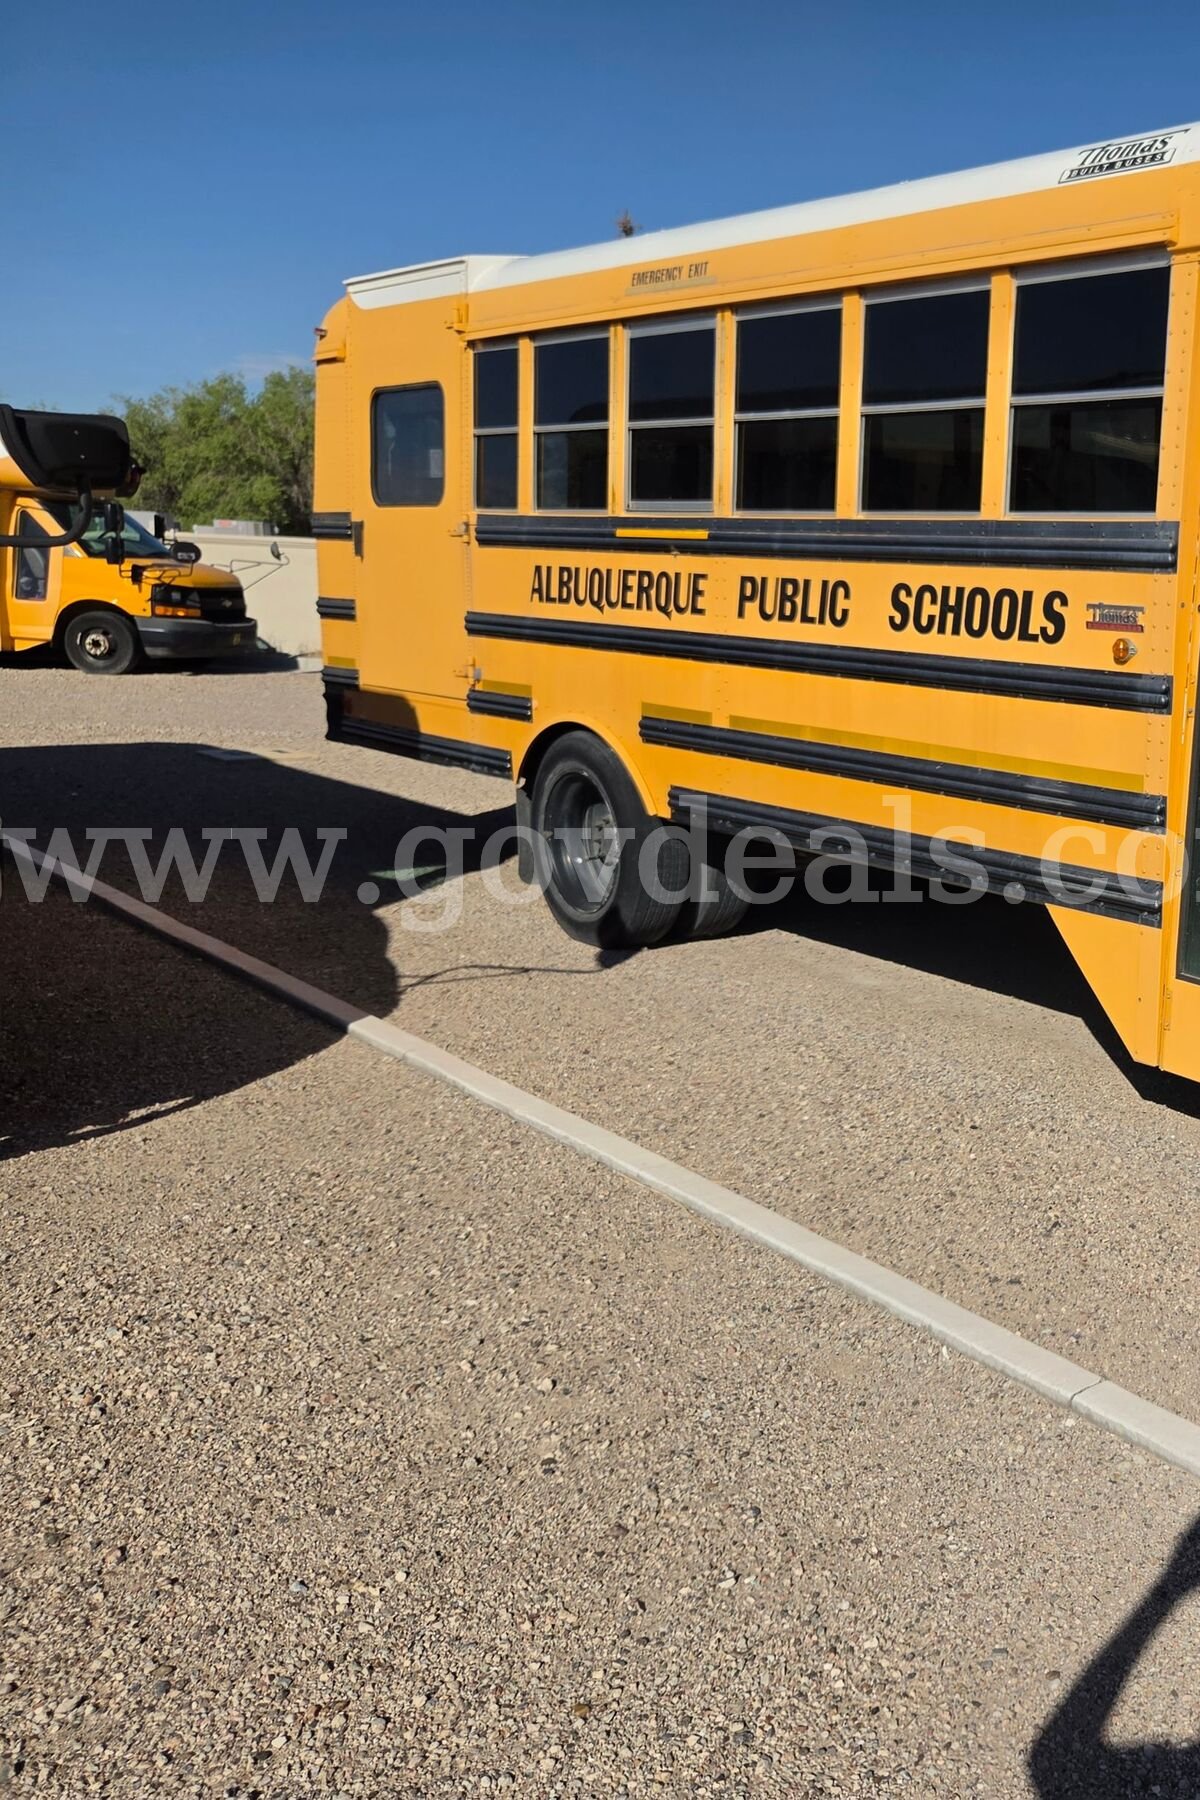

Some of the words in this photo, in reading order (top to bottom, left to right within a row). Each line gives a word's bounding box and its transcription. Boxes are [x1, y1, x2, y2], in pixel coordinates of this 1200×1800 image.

[1078, 128, 1190, 166] Thomas
[1069, 163, 1110, 177] BUILT
[1114, 152, 1164, 169] BUSES
[632, 266, 683, 287] EMERGENCY
[688, 261, 709, 278] EXIT
[530, 565, 709, 621] ALBUQUERQUE
[737, 575, 850, 628] PUBLIC
[888, 582, 1068, 645] SCHOOLS
